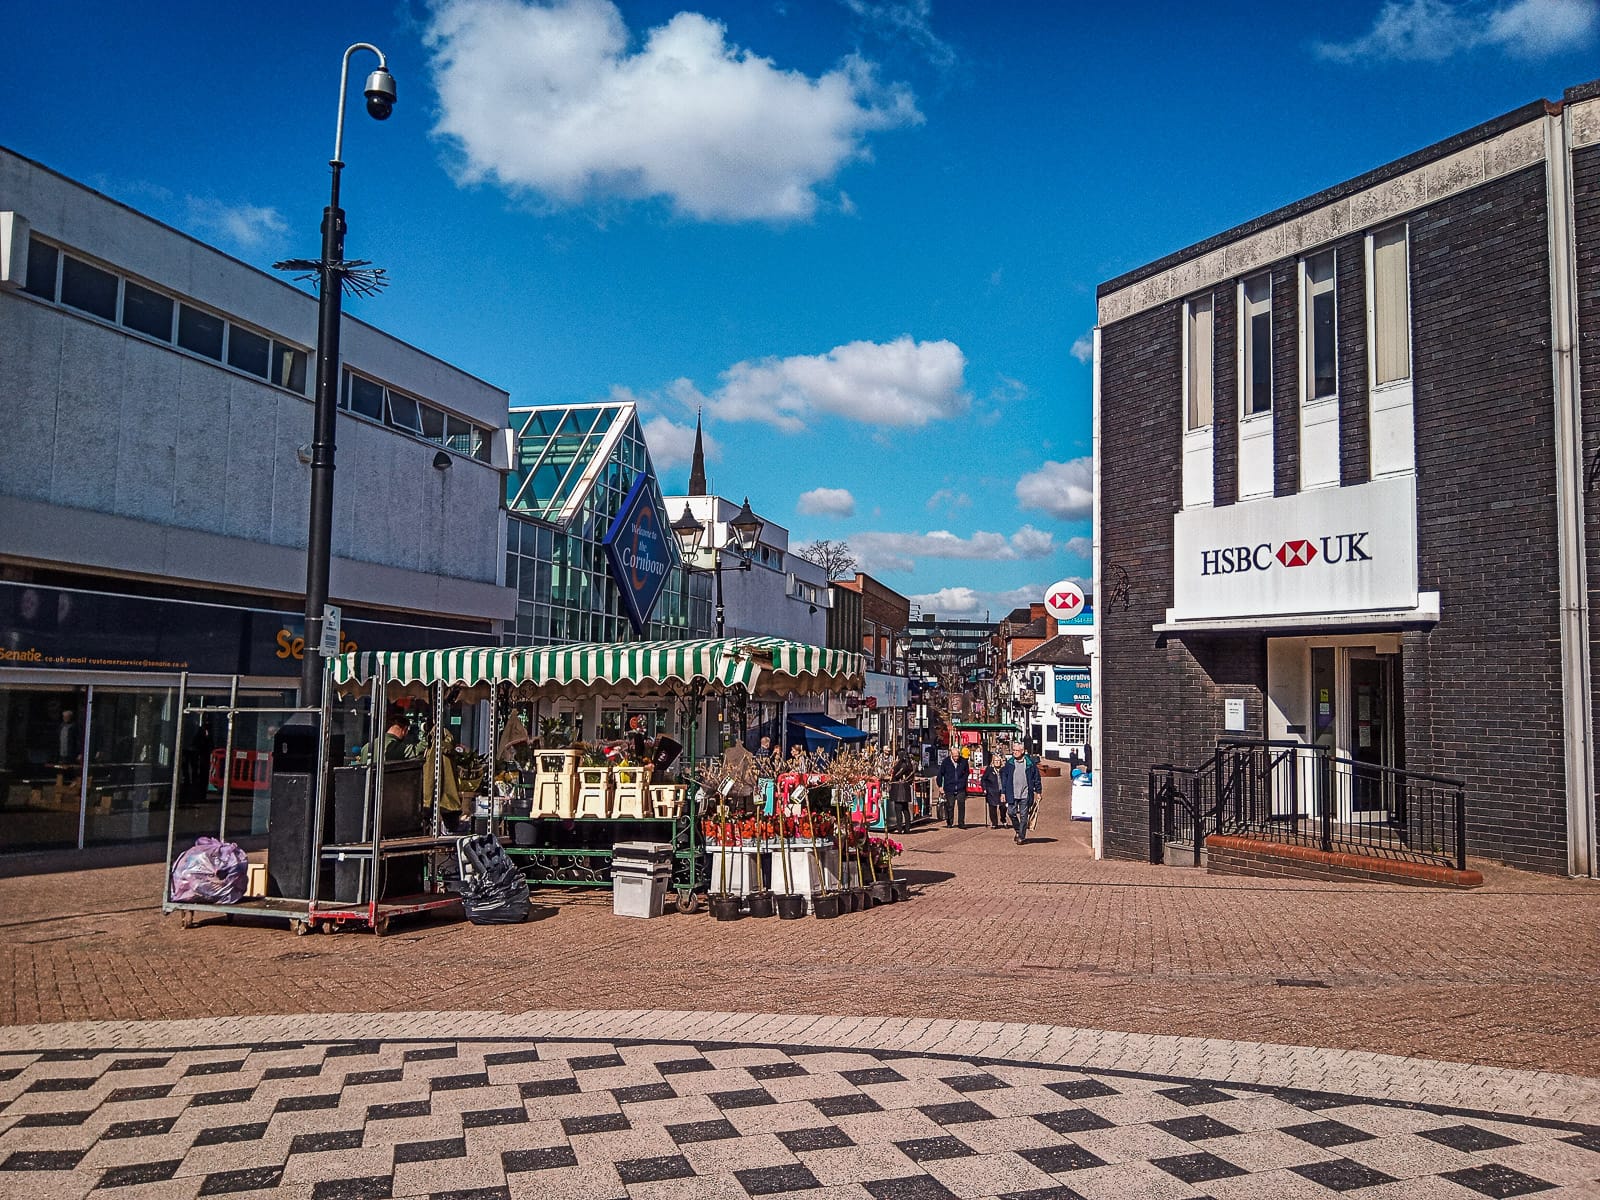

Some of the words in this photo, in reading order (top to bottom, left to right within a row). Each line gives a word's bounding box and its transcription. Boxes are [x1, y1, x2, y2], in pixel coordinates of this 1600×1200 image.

[639, 541, 648, 552] the
[1200, 542, 1273, 577] HSBC
[1319, 531, 1373, 565] UK
[622, 547, 665, 575] Cornbow
[1055, 674, 1091, 682] co-operative
